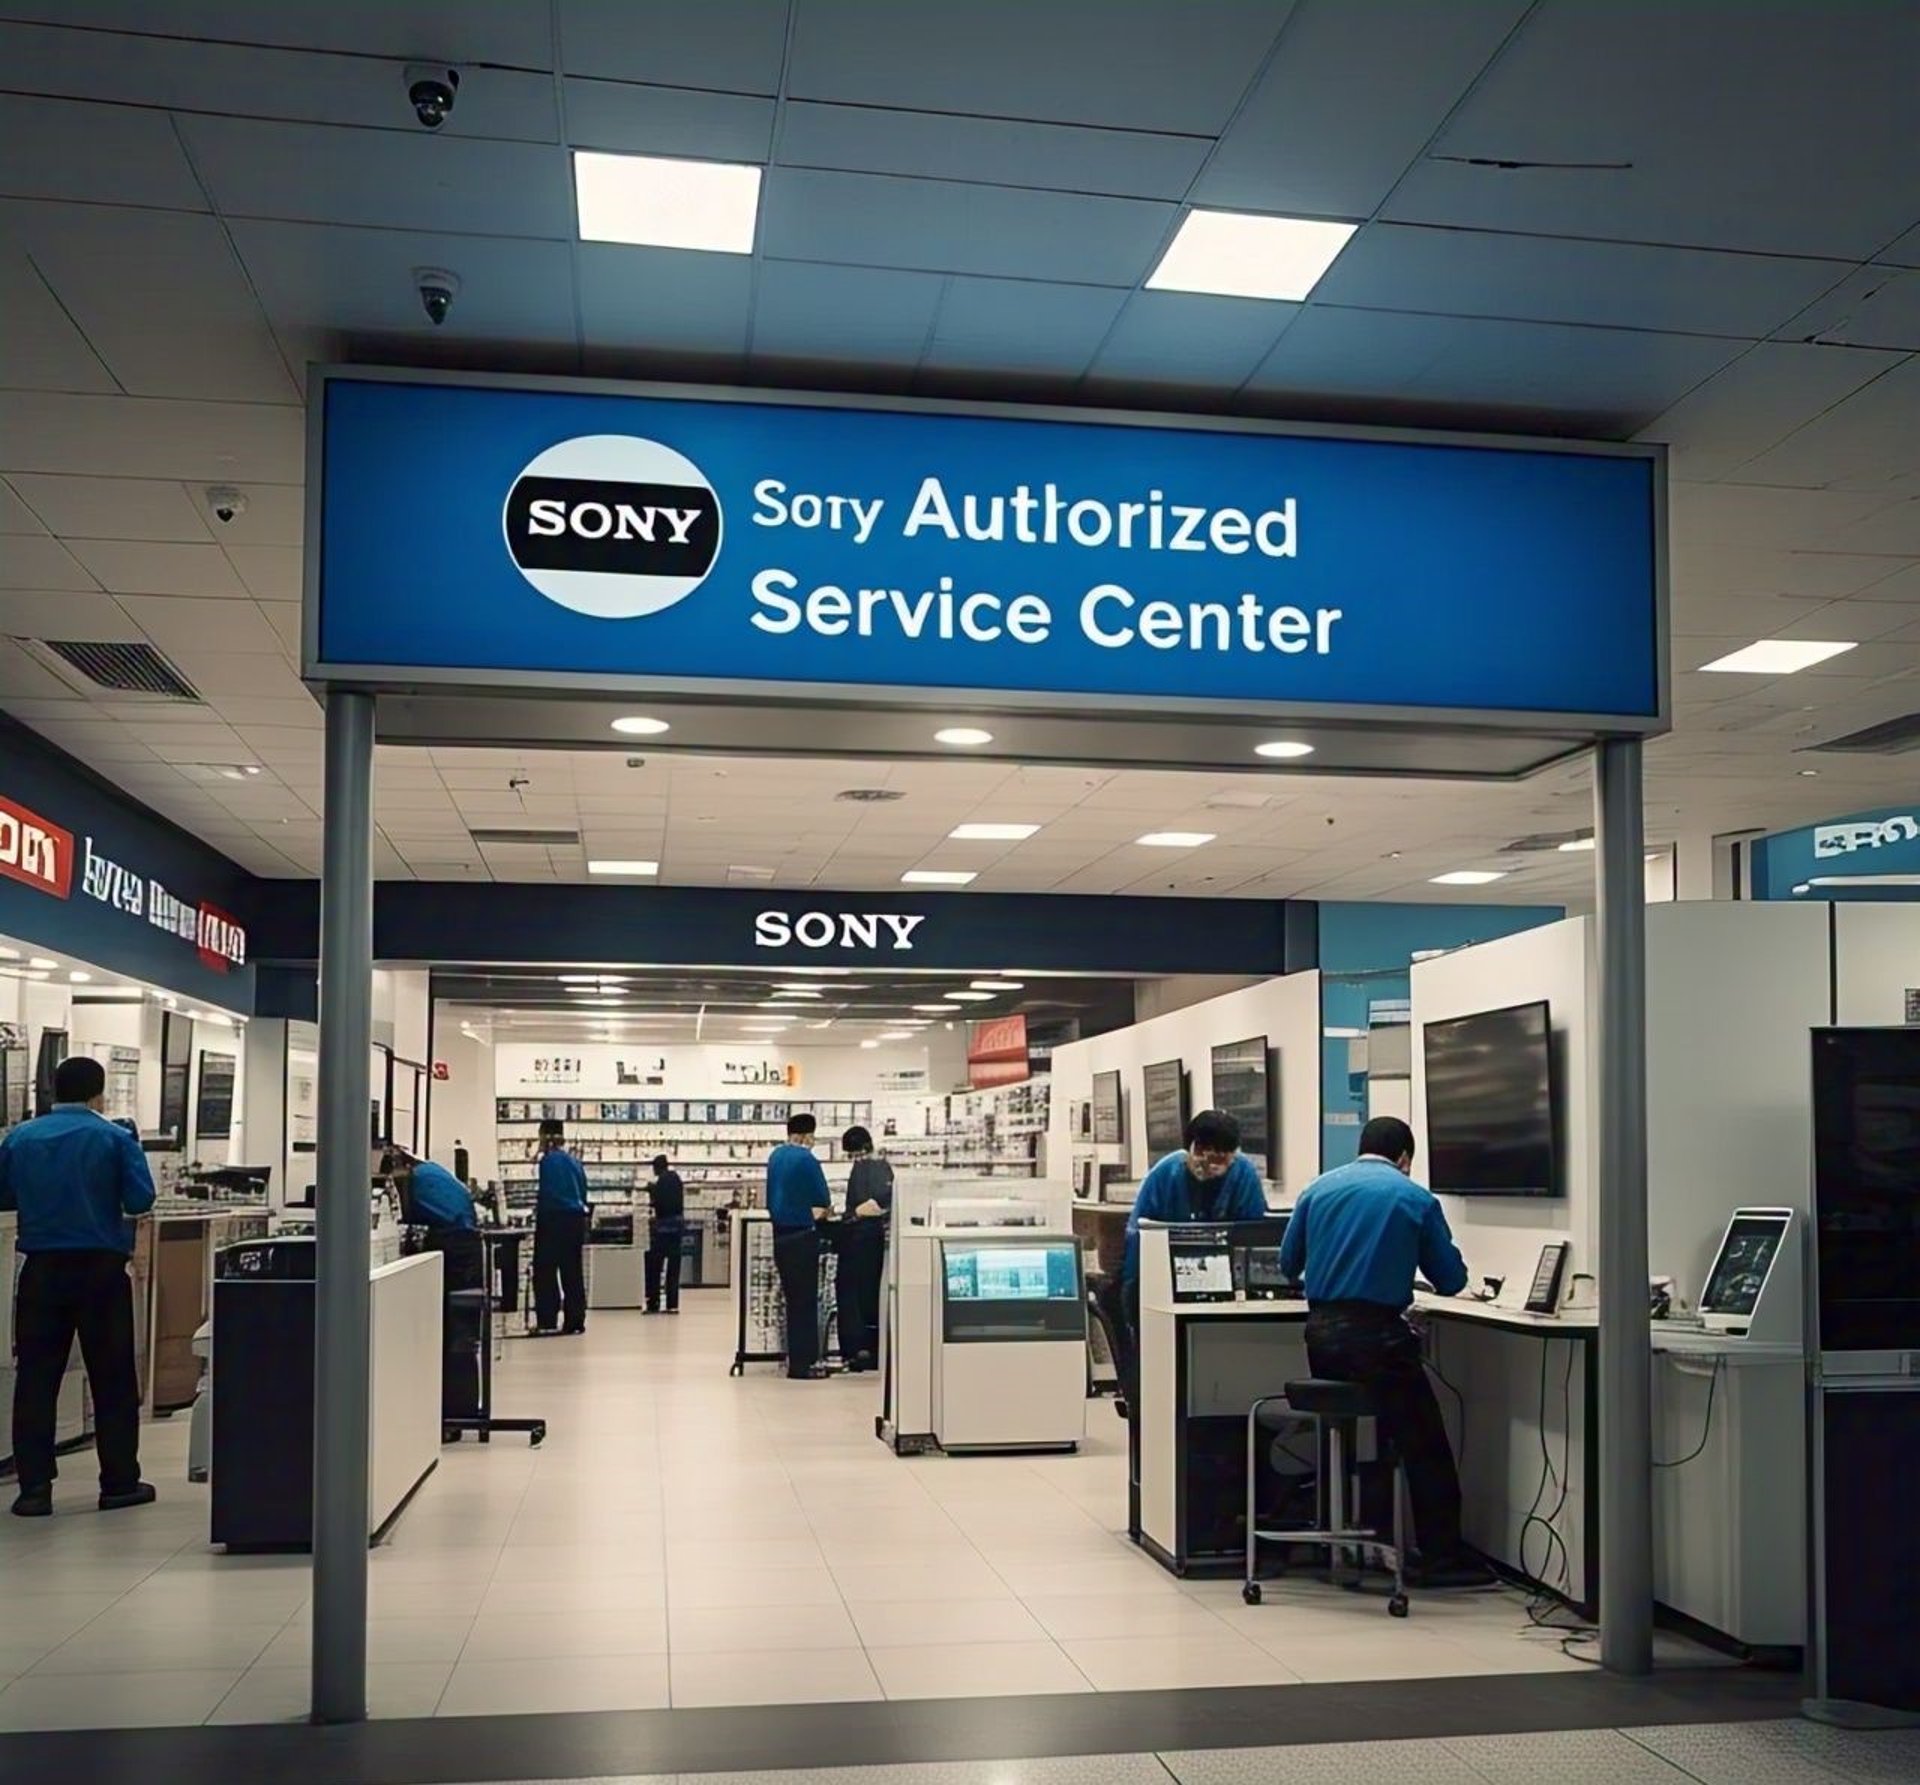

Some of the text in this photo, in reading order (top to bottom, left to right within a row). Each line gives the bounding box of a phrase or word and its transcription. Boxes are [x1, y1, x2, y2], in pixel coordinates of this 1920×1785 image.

[528, 499, 701, 544] SONY
[750, 569, 1342, 654] Service Center
[755, 911, 925, 949] SONY
